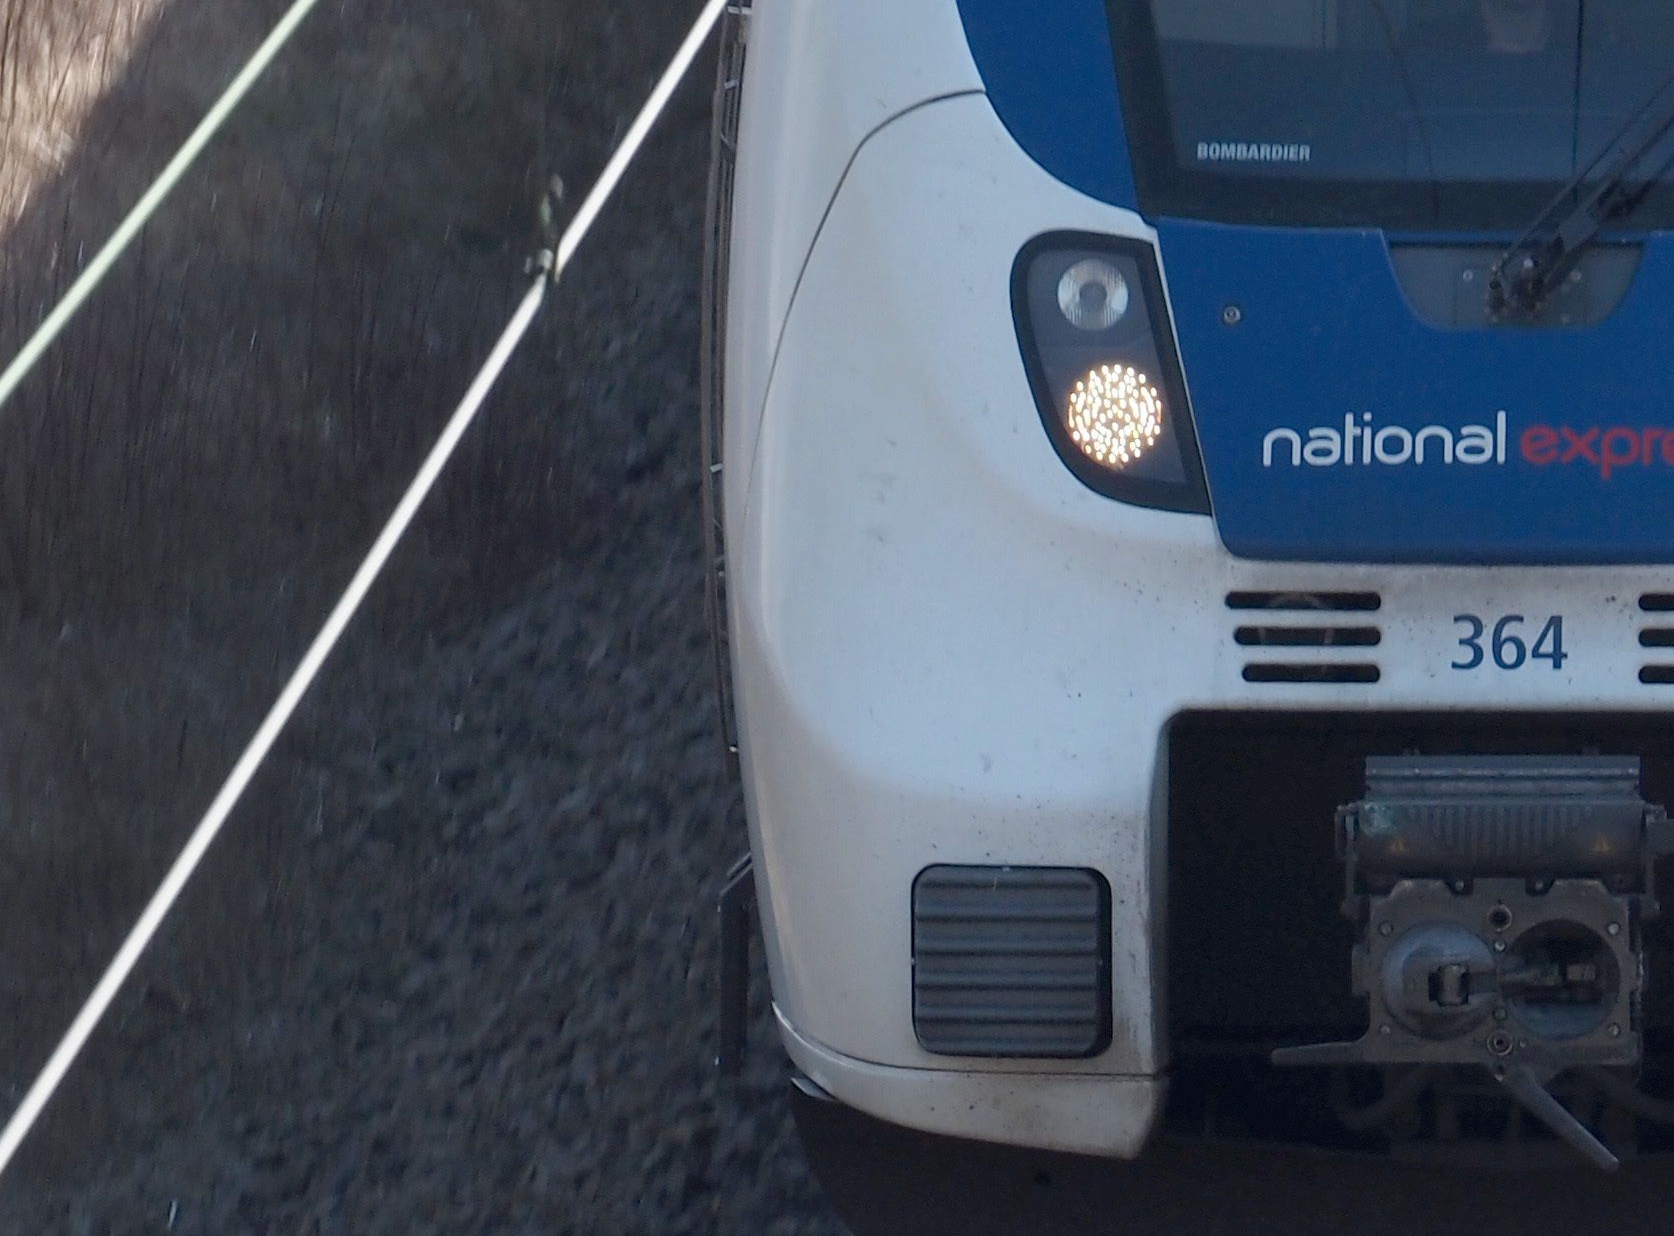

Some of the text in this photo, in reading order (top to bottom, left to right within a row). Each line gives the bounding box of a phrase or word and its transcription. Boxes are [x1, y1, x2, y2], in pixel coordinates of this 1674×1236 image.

[1197, 142, 1311, 162] BOMBARDIER
[1262, 410, 1507, 467] national
[1450, 613, 1569, 671] 364
